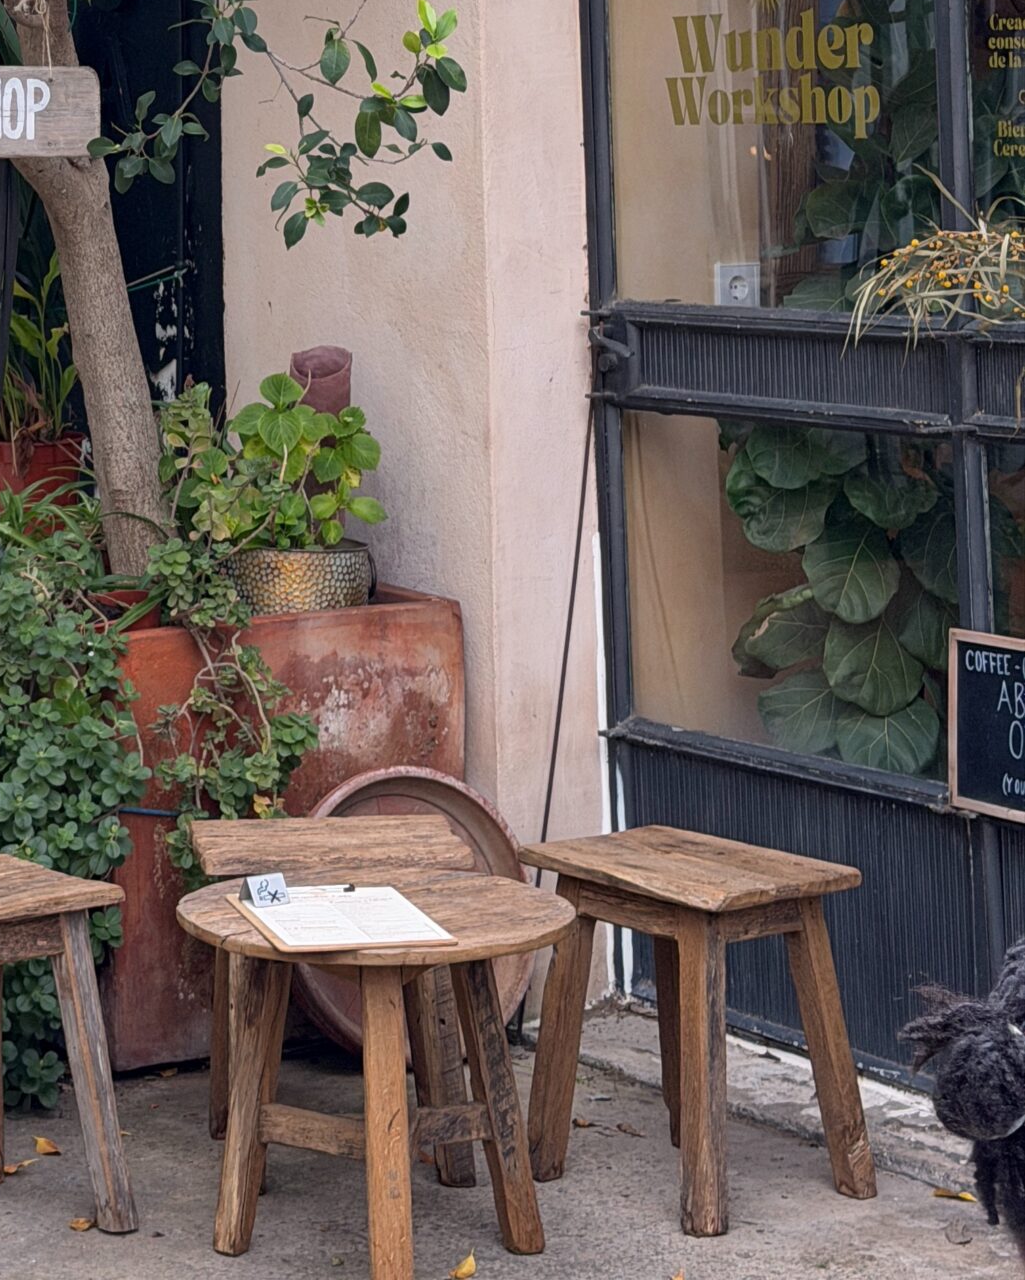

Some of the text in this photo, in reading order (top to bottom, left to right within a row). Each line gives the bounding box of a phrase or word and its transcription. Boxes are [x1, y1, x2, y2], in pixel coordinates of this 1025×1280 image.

[672, 8, 874, 73] Wunder
[988, 51, 1022, 69] de la
[666, 75, 880, 140] Workshop
[965, 649, 1012, 676] COFFEE
